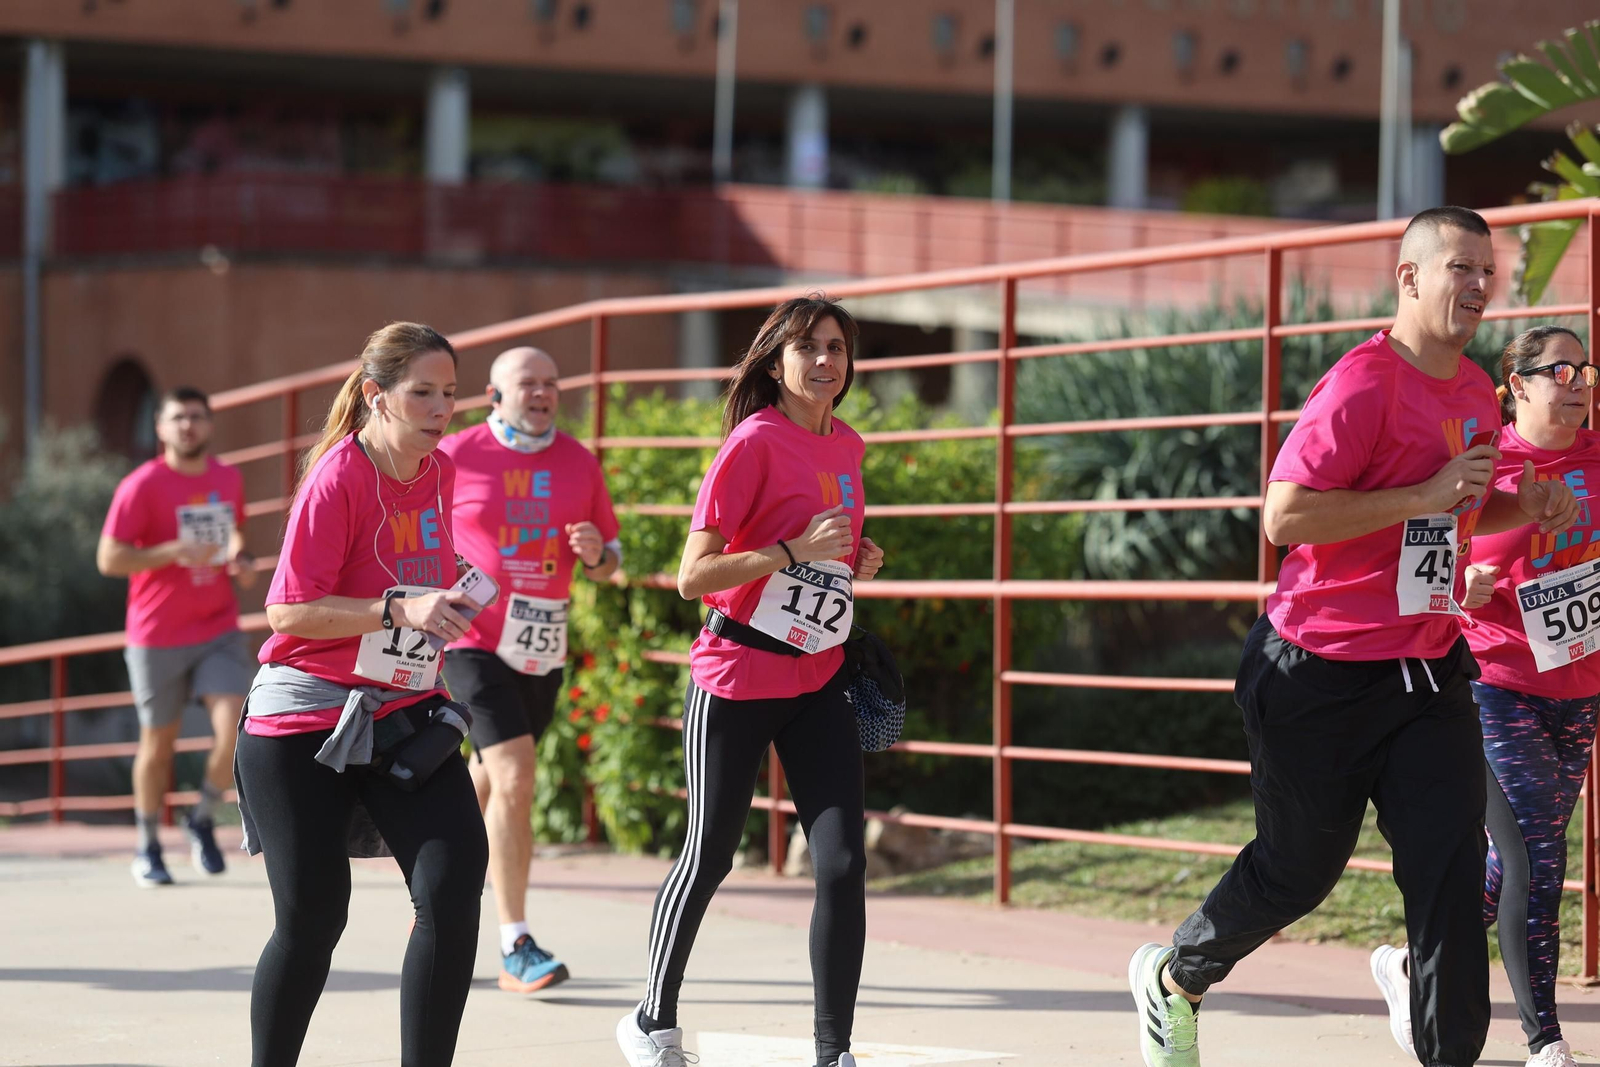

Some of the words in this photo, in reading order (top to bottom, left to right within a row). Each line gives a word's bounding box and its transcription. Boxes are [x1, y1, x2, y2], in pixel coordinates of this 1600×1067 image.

[503, 469, 552, 498] WE
[816, 472, 855, 509] WE
[507, 501, 549, 524] RUN
[388, 508, 441, 554] WE
[498, 525, 560, 558] UMA
[400, 556, 440, 585] RUN
[785, 565, 825, 586] UMA
[780, 584, 847, 634] 112
[1430, 598, 1449, 608] WE
[1523, 586, 1570, 608] UMA
[512, 606, 546, 622] UMA
[1542, 591, 1600, 642] 509
[516, 625, 561, 653] 455
[790, 629, 808, 644] WE
[1570, 646, 1585, 657] WE
[394, 671, 411, 684] WE
